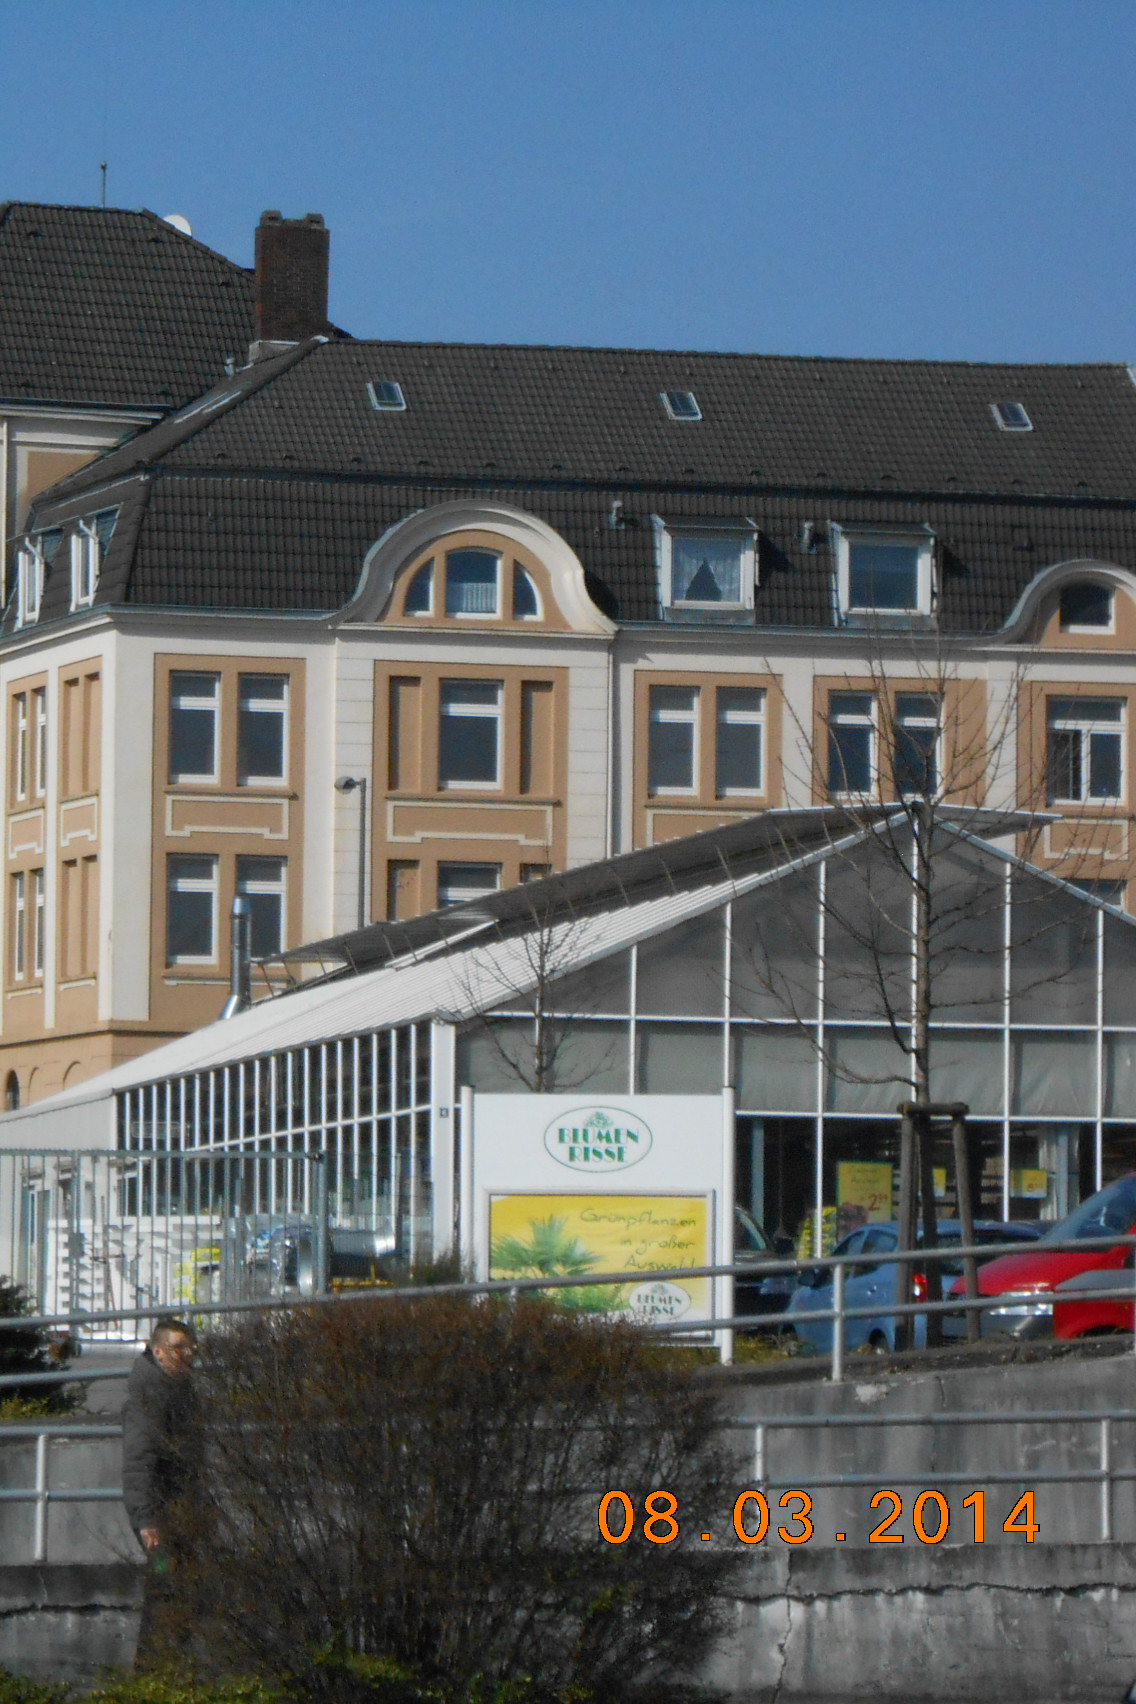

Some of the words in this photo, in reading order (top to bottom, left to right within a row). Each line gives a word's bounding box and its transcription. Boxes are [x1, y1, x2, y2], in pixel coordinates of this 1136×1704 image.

[558, 1127, 640, 1144] BLUMEN
[568, 1146, 627, 1162] RISSE
[579, 1207, 696, 1230] Grünpflanzen
[620, 1237, 632, 1247] in
[635, 1235, 695, 1255] großer
[637, 1293, 683, 1306] BLUMEN
